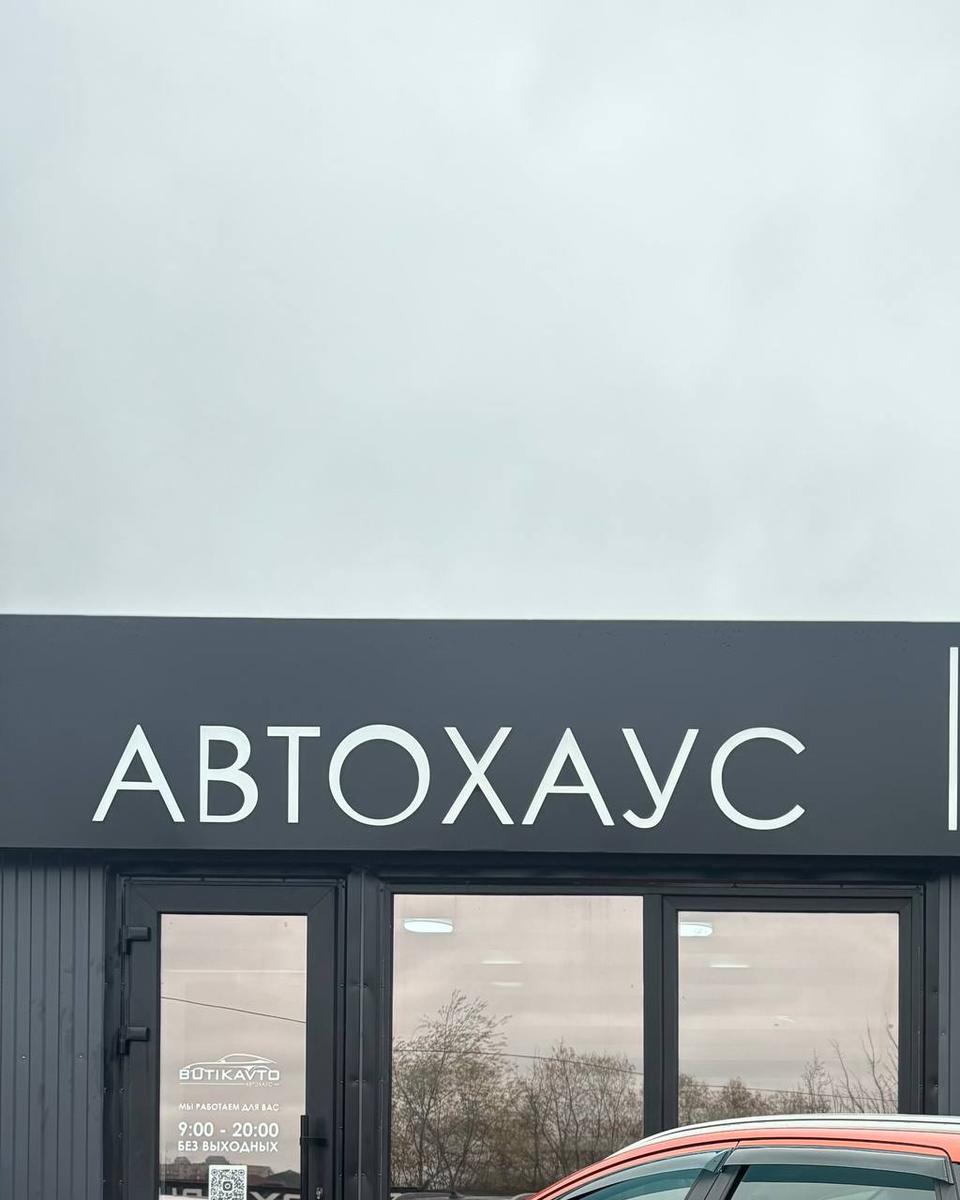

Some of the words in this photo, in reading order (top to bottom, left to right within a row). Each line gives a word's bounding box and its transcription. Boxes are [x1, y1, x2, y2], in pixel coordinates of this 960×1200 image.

[92, 723, 807, 831] АВТОХАУС
[179, 1069, 280, 1081] BUTIKAVTO
[179, 1103, 194, 1111] МЫ
[196, 1103, 240, 1111] РАБОТАЕМ
[241, 1104, 259, 1112] ДЛЯ
[261, 1103, 280, 1112] ВАС
[178, 1122, 214, 1137] 9:00
[232, 1122, 279, 1137] 20:00
[178, 1141, 199, 1151] БЕЗ
[202, 1141, 279, 1153] ВЫХОДНЫХ
